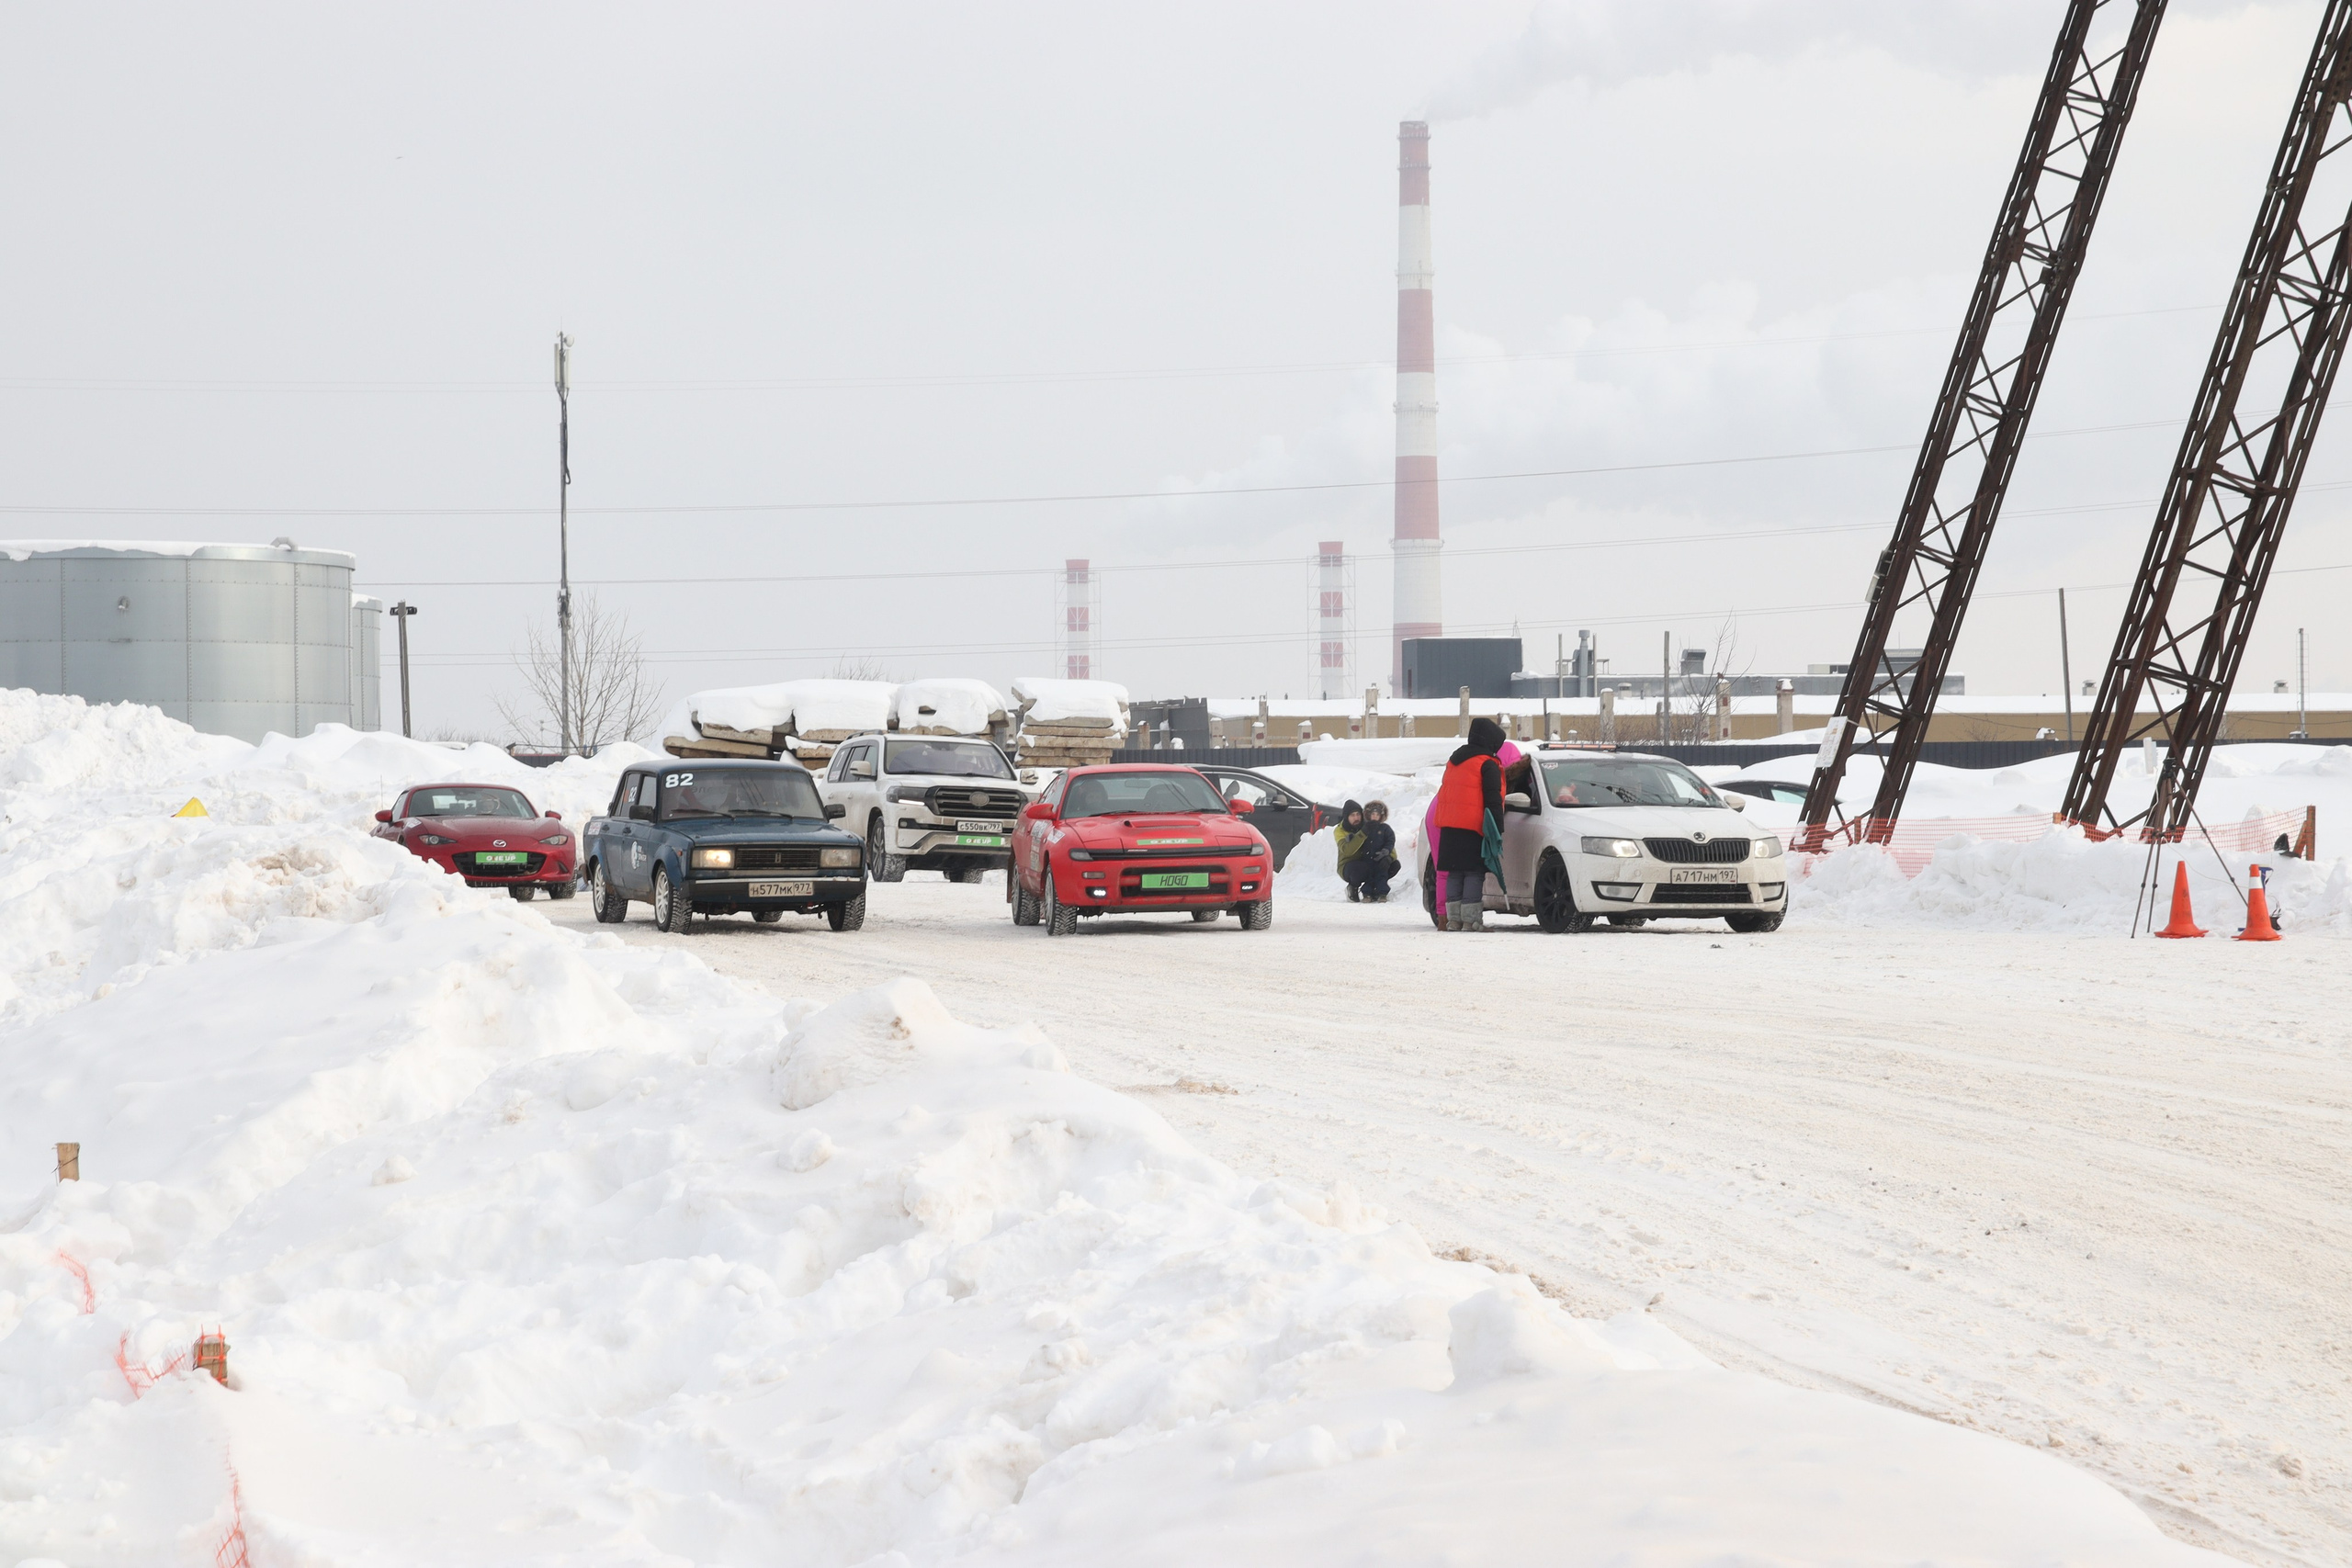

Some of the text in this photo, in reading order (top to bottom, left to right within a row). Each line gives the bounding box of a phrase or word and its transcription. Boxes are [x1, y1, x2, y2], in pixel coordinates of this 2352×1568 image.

[665, 773, 694, 789] 82
[1675, 870, 1735, 882] А717НМ 197
[752, 883, 810, 896] Н577МК 977
